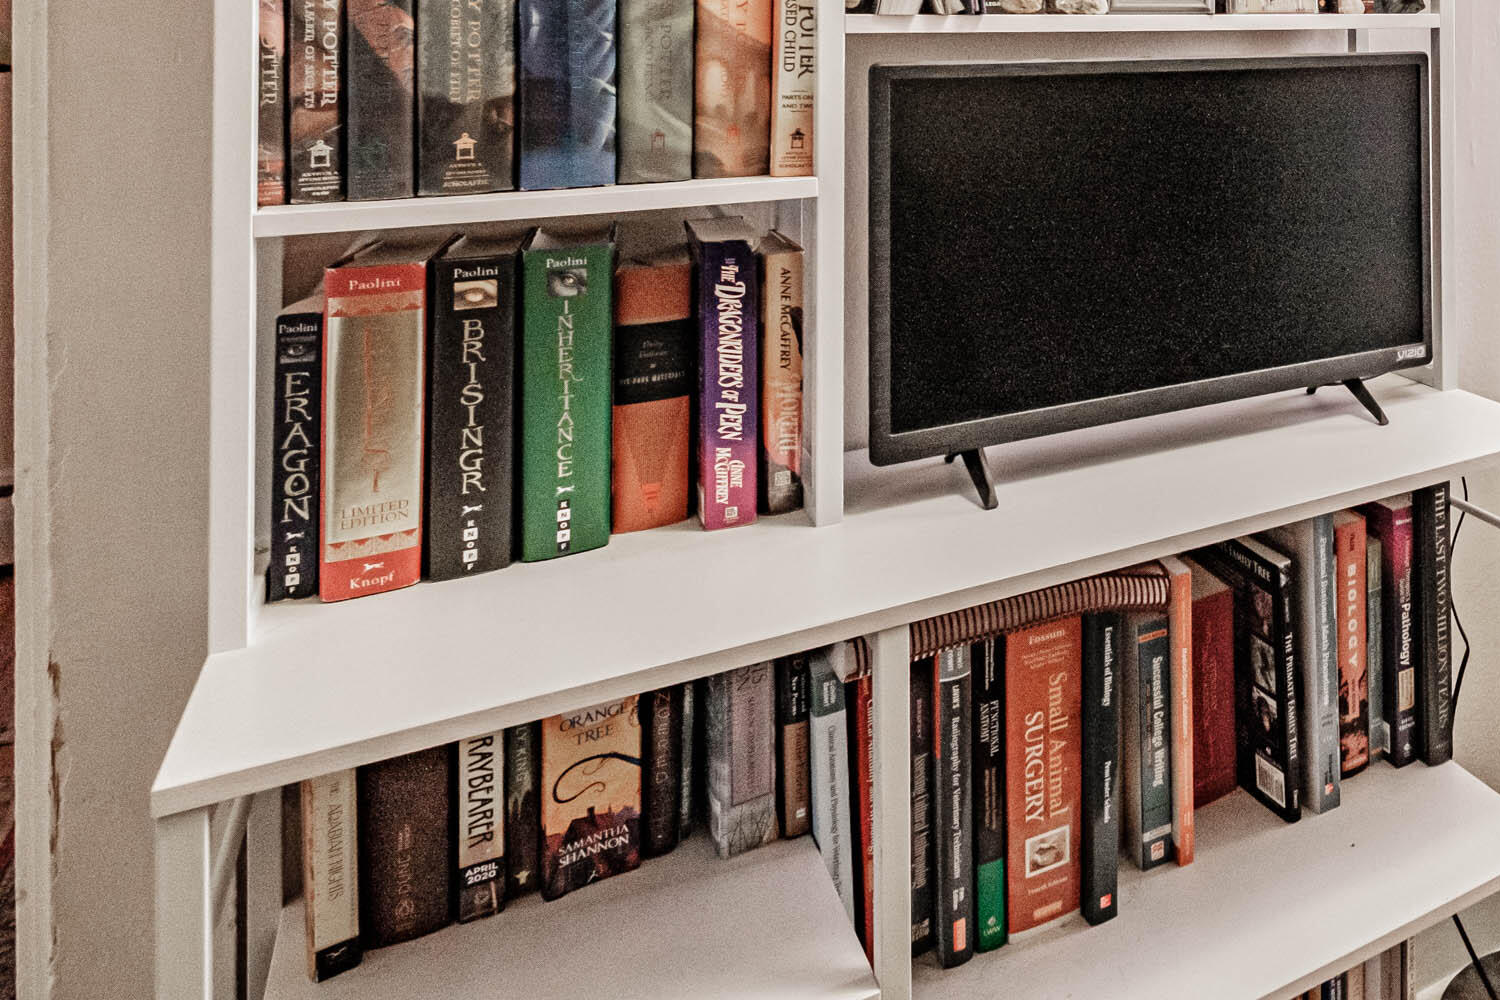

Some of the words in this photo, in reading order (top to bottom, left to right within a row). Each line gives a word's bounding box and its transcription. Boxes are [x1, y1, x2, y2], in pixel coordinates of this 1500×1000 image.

[304, 45, 314, 60] OF
[320, 12, 339, 108] POTTER
[465, 20, 482, 103] POTTER
[783, 29, 797, 73] CHILD
[453, 266, 499, 279] Paolini
[545, 257, 588, 268] Paolini
[720, 263, 735, 282] THE
[349, 278, 401, 291] Paolini
[780, 267, 791, 301] ANNE
[278, 322, 318, 334] Paolini
[714, 281, 746, 387] DRAGONRIDERS
[779, 302, 791, 371] McCAFFREY
[1396, 346, 1426, 361] VIZIO
[459, 319, 486, 495] BRISINGR
[557, 299, 583, 479] INHERITANCE
[725, 388, 738, 401] OF
[714, 400, 747, 441] PERN
[281, 371, 314, 522] ERAGON
[729, 459, 745, 488] ANNE
[340, 511, 409, 530] EDITION
[341, 500, 409, 520] LIMITED
[556, 500, 571, 551] KNOPF
[1434, 488, 1445, 524] THE
[463, 519, 478, 570] KNOPF
[1319, 537, 1329, 580] Practical
[1435, 525, 1446, 562] LAST
[285, 545, 300, 594] KNOPF
[350, 571, 395, 590] Knopf
[1436, 563, 1446, 605] TWO
[1320, 580, 1329, 623] Business
[1347, 562, 1358, 668] BIOLOGY
[1028, 629, 1065, 646] Fossum
[1104, 626, 1113, 669] Essentials
[1284, 631, 1294, 654] THE
[1321, 624, 1330, 651] Math
[1399, 603, 1412, 666] Pathology
[1437, 606, 1448, 672] MILLION
[791, 675, 799, 692] New
[1101, 677, 1113, 707] Biology
[1103, 669, 1112, 677] of
[1151, 655, 1164, 709] Successful
[1285, 655, 1295, 698] PRIMATE
[1321, 652, 1331, 706] Procedures
[791, 693, 799, 717] Poems
[1049, 671, 1069, 733] Small
[1287, 699, 1297, 735] FAMILY
[1438, 674, 1449, 728] YEARS
[573, 723, 614, 746] TREE
[827, 725, 837, 752] Clinical
[979, 702, 989, 744] ANATOMY
[990, 699, 999, 757] FUNCTIONAL
[1151, 711, 1164, 748] College
[950, 716, 961, 772] Radiography
[1288, 735, 1298, 761] TREE
[952, 773, 961, 786] for
[1024, 711, 1045, 824] SURGERY
[1049, 740, 1071, 819] Animal
[1152, 749, 1165, 788] Writing
[467, 735, 494, 849] RAYBEARER
[951, 787, 962, 831] Veterinary
[558, 824, 629, 855] SAMANTHA
[558, 834, 630, 868] SHANNON
[952, 831, 964, 880] Technicians
[465, 862, 498, 879] APRIL
[467, 869, 497, 886] 2020
